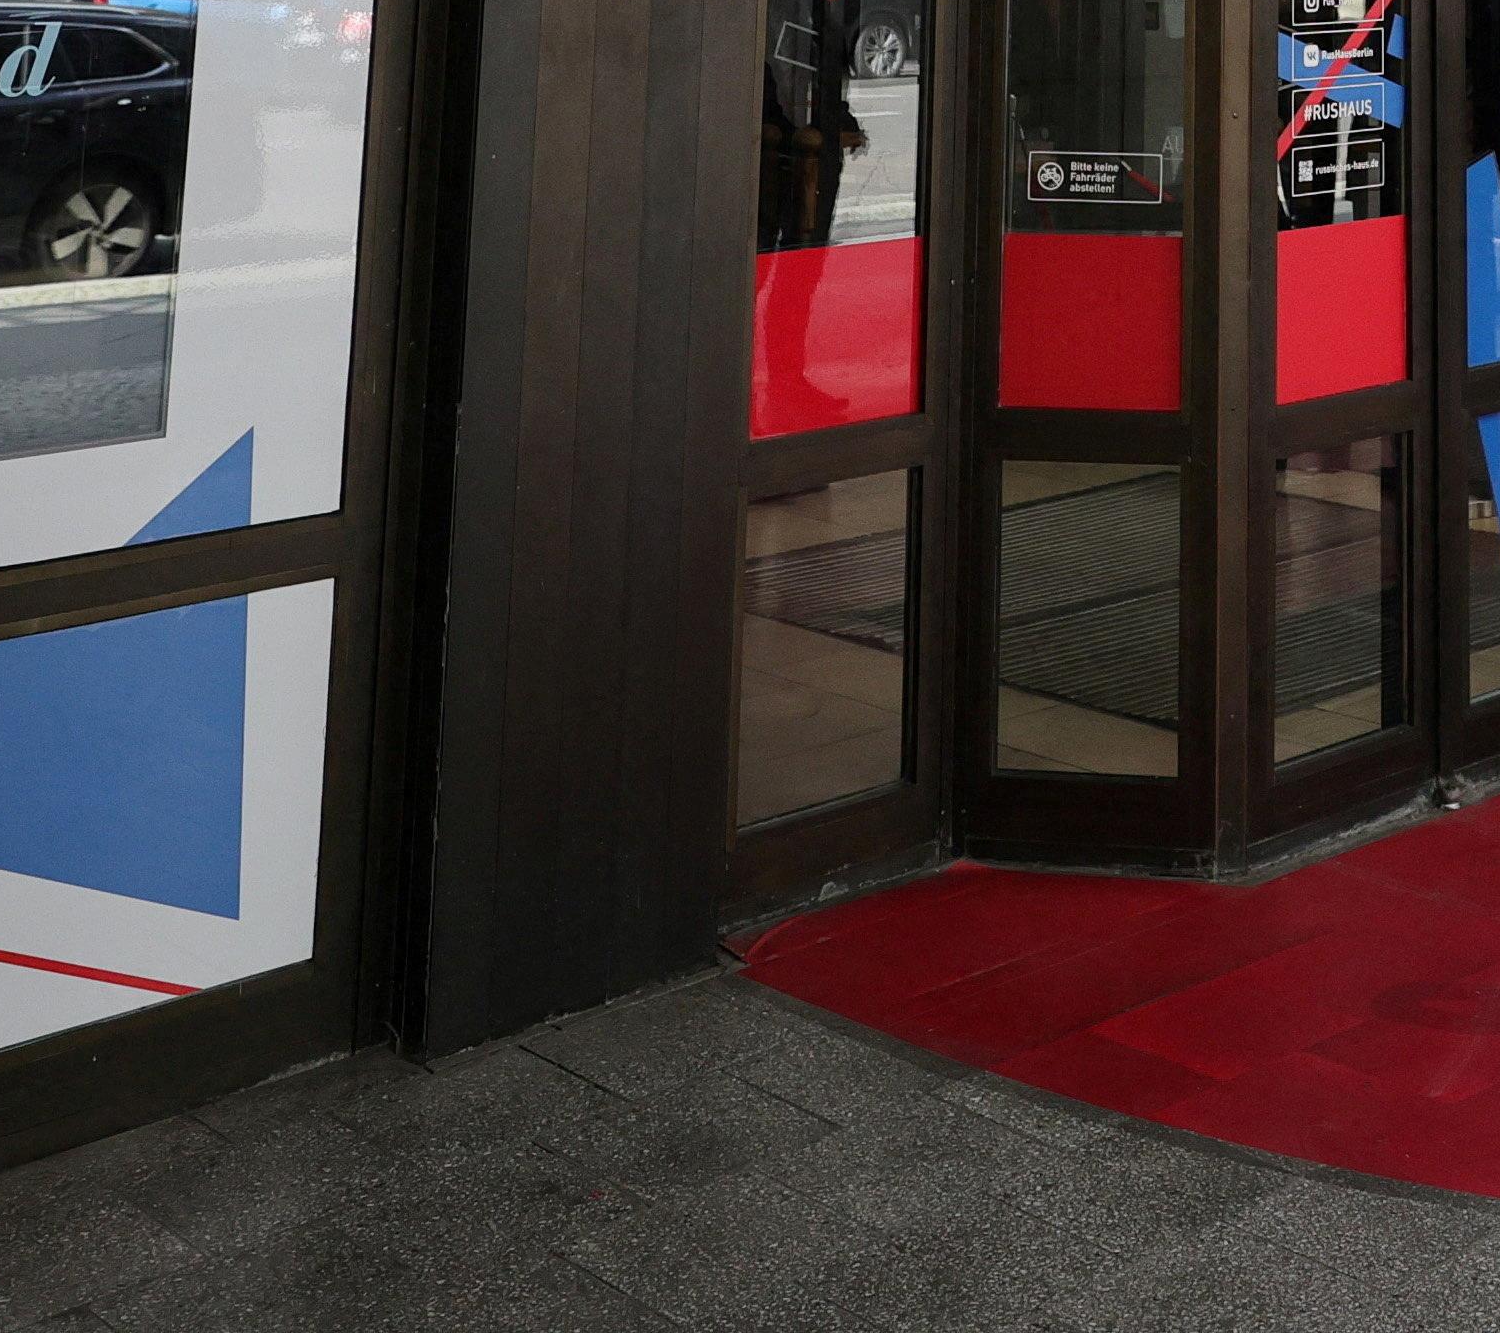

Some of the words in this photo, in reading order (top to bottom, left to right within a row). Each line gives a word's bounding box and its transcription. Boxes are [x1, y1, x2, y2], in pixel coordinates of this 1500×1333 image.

[1321, 47, 1374, 60] RusHausBerlin
[1304, 99, 1373, 122] #RUSHAUS
[1071, 161, 1092, 171] Bitte
[1094, 162, 1119, 172] keine
[1070, 172, 1116, 183] Fahrräder
[1070, 183, 1115, 193] abstellen!
